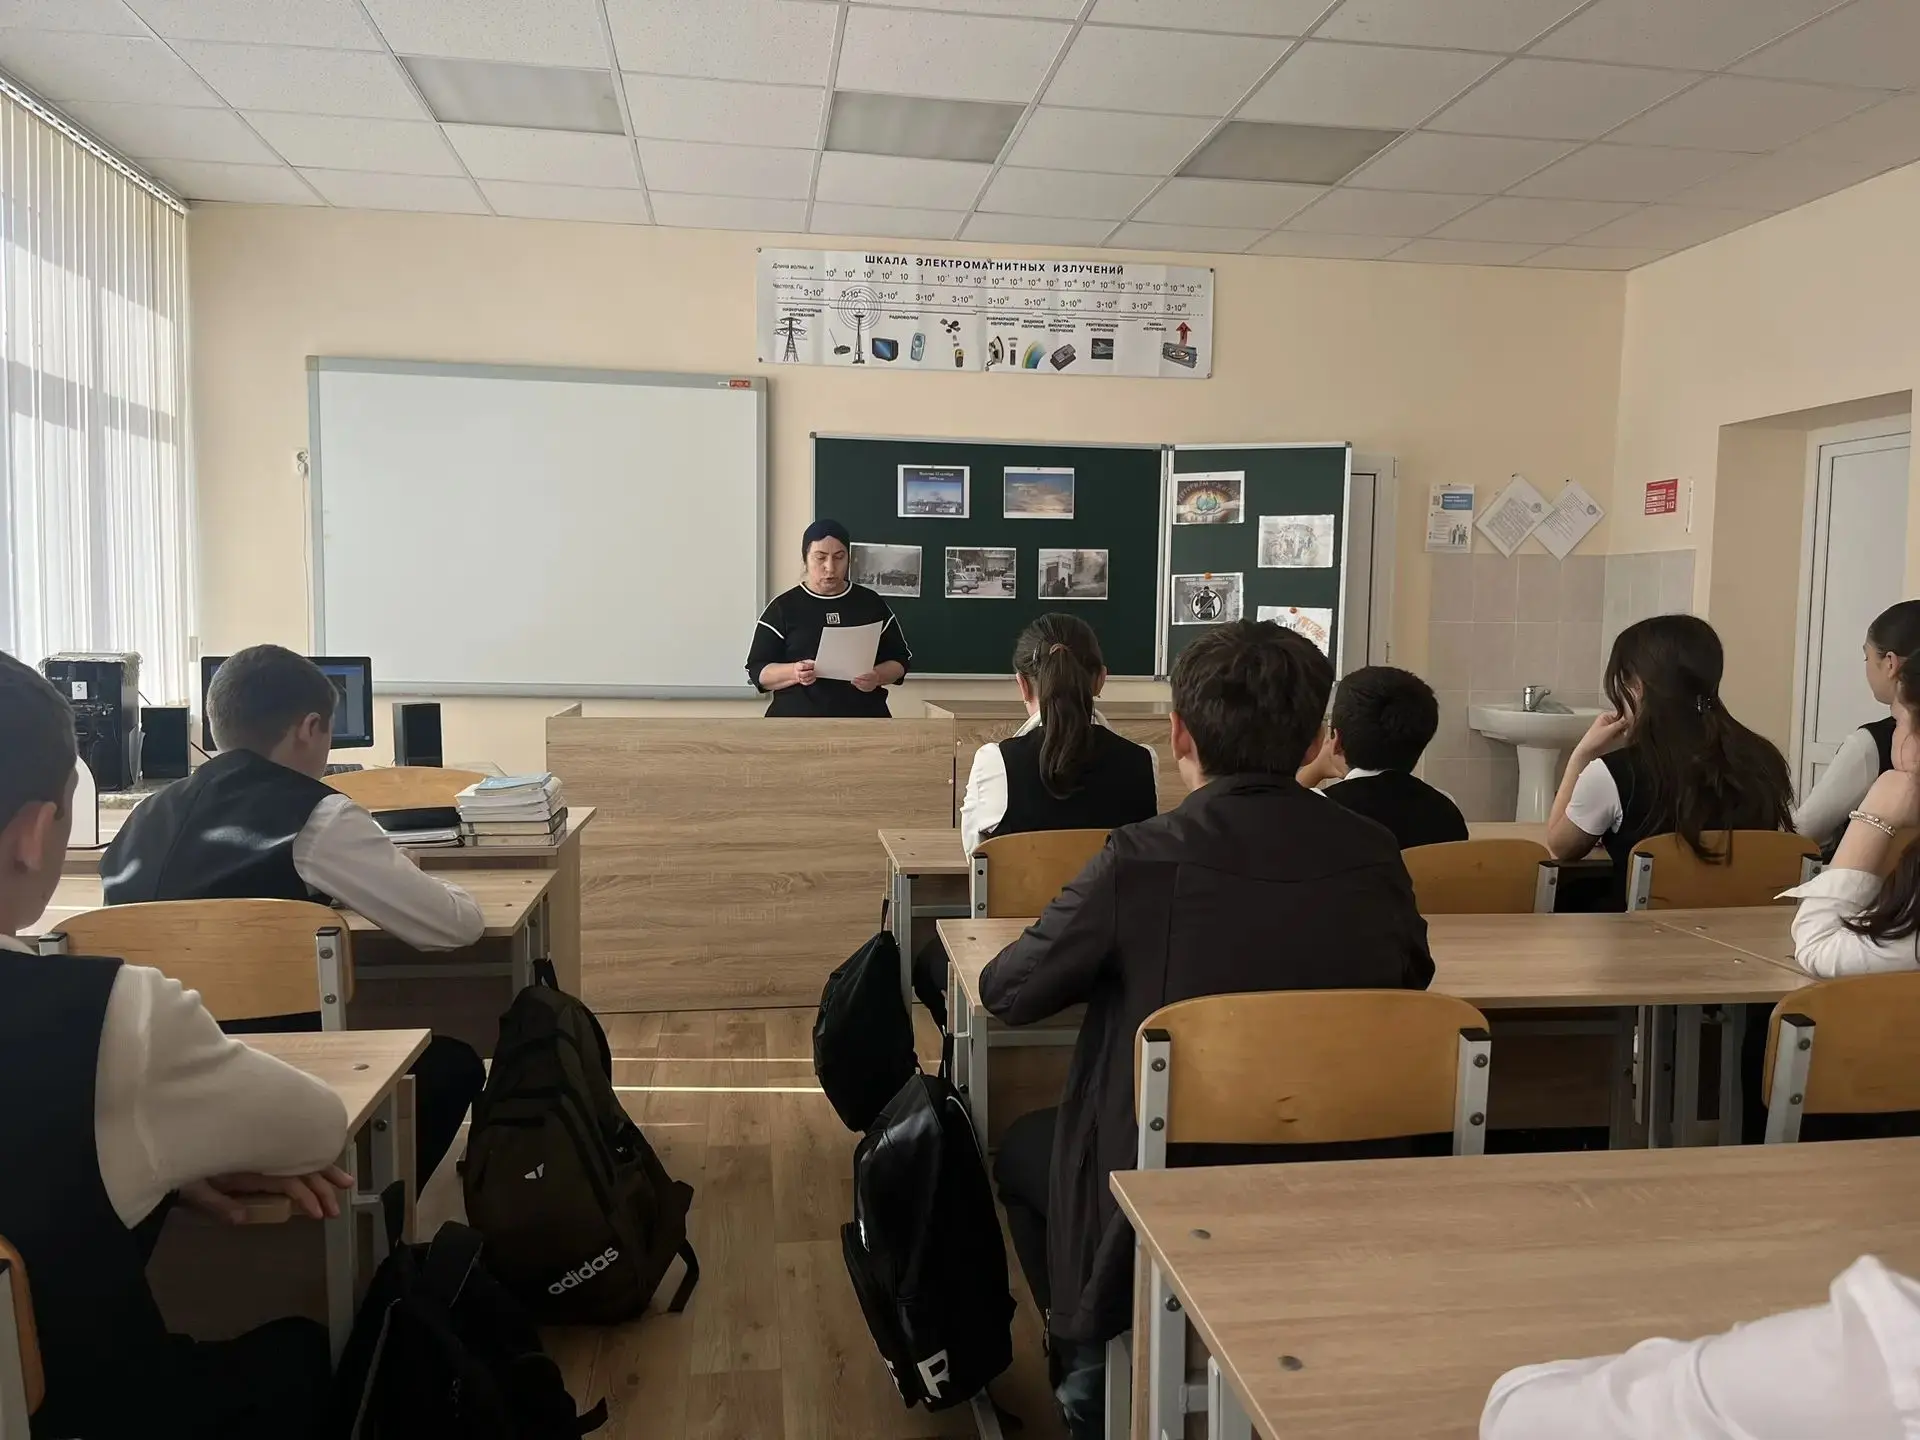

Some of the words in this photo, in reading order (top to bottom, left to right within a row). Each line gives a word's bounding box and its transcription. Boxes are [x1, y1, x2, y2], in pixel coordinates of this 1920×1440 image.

[865, 255, 908, 265] ШКАЛА
[916, 258, 1045, 272] ЭЛЕКТРОМАГНИТНЫХ
[1053, 264, 1124, 275] ИЗЛУЧЕНИЙ
[900, 273, 909, 281] 10
[548, 1247, 619, 1295] adidas
